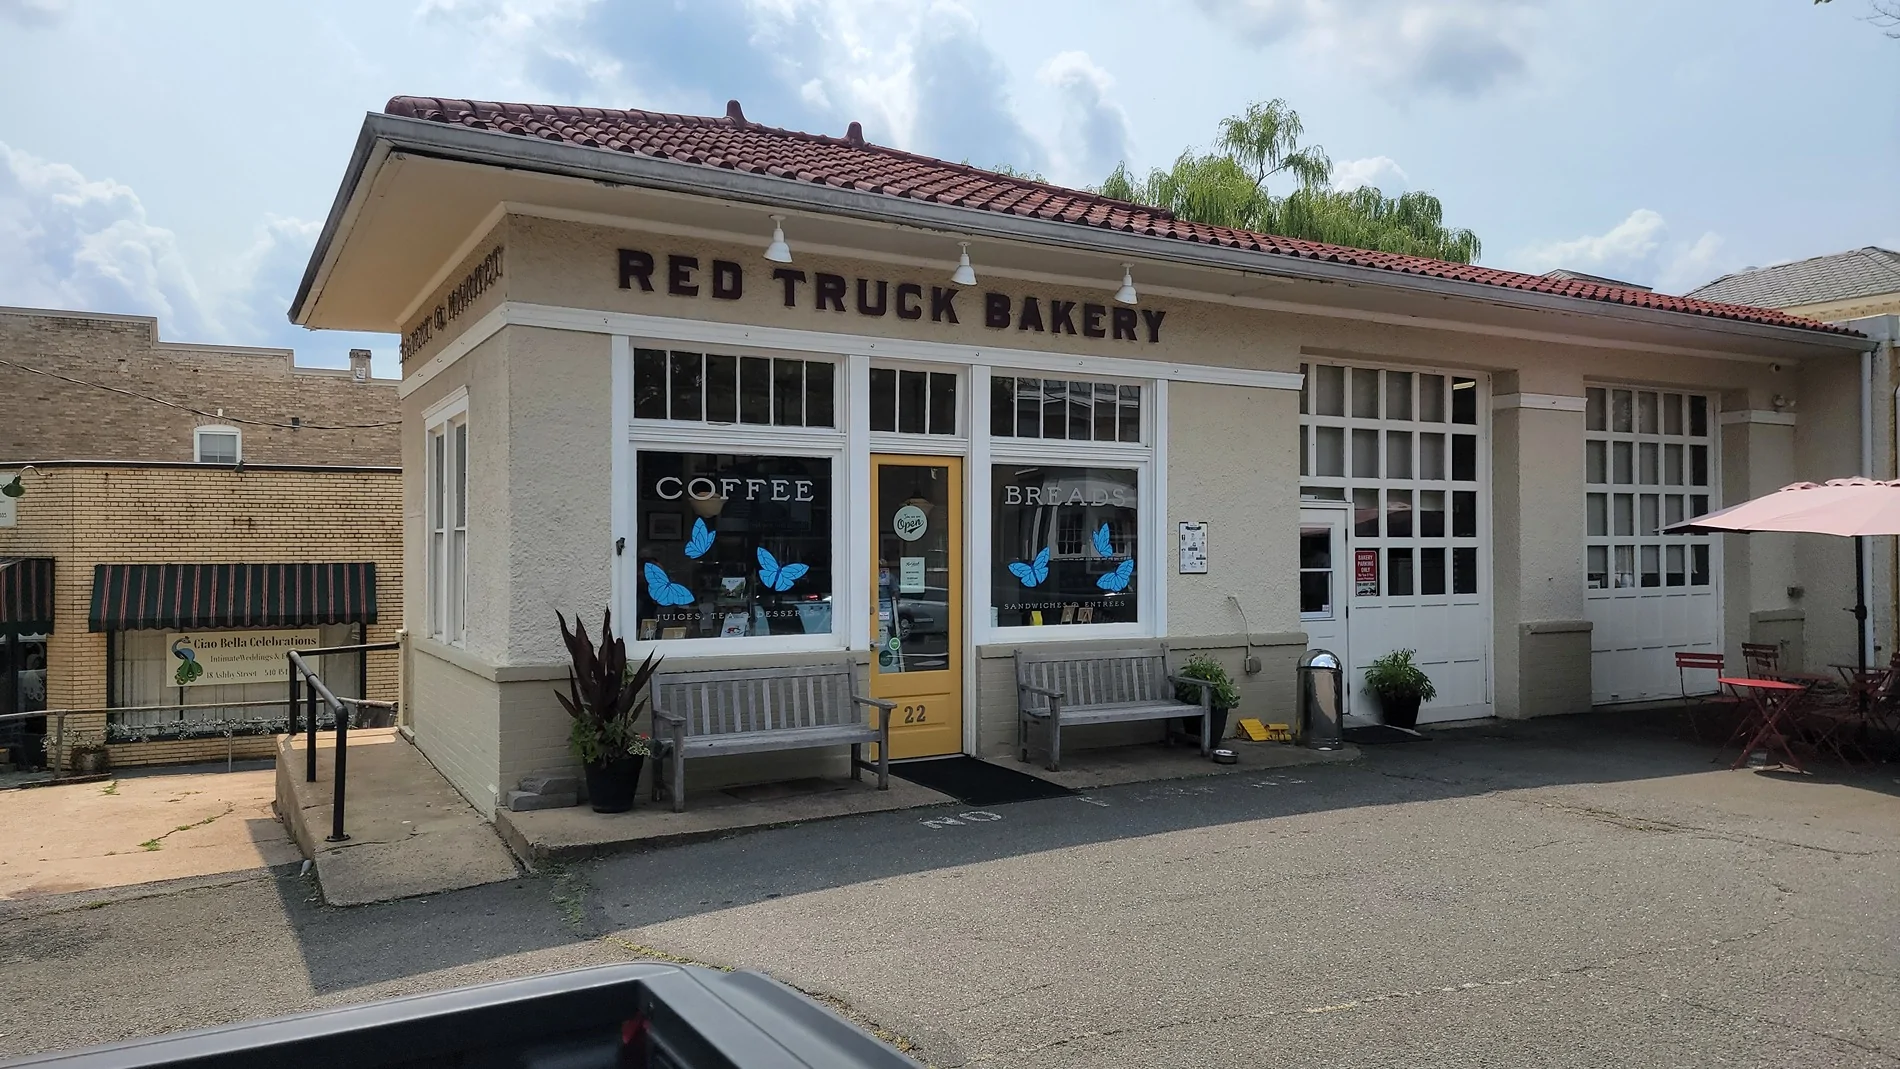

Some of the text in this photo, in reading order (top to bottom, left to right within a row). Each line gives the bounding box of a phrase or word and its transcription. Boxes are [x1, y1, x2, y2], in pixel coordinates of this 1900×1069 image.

[617, 248, 1167, 344] RED TRUCK BAKERY
[655, 476, 815, 502] COFFEE
[1004, 485, 1126, 507] BREADS
[897, 518, 924, 533] Open
[1004, 602, 1067, 610] SANDWICHES
[1084, 600, 1126, 608] ENTREES
[711, 612, 735, 620] TEA
[756, 609, 815, 619] DESSERTS
[193, 635, 317, 649] Ciao Bella Celebrations
[236, 670, 257, 679] Street
[904, 704, 926, 724] 22
